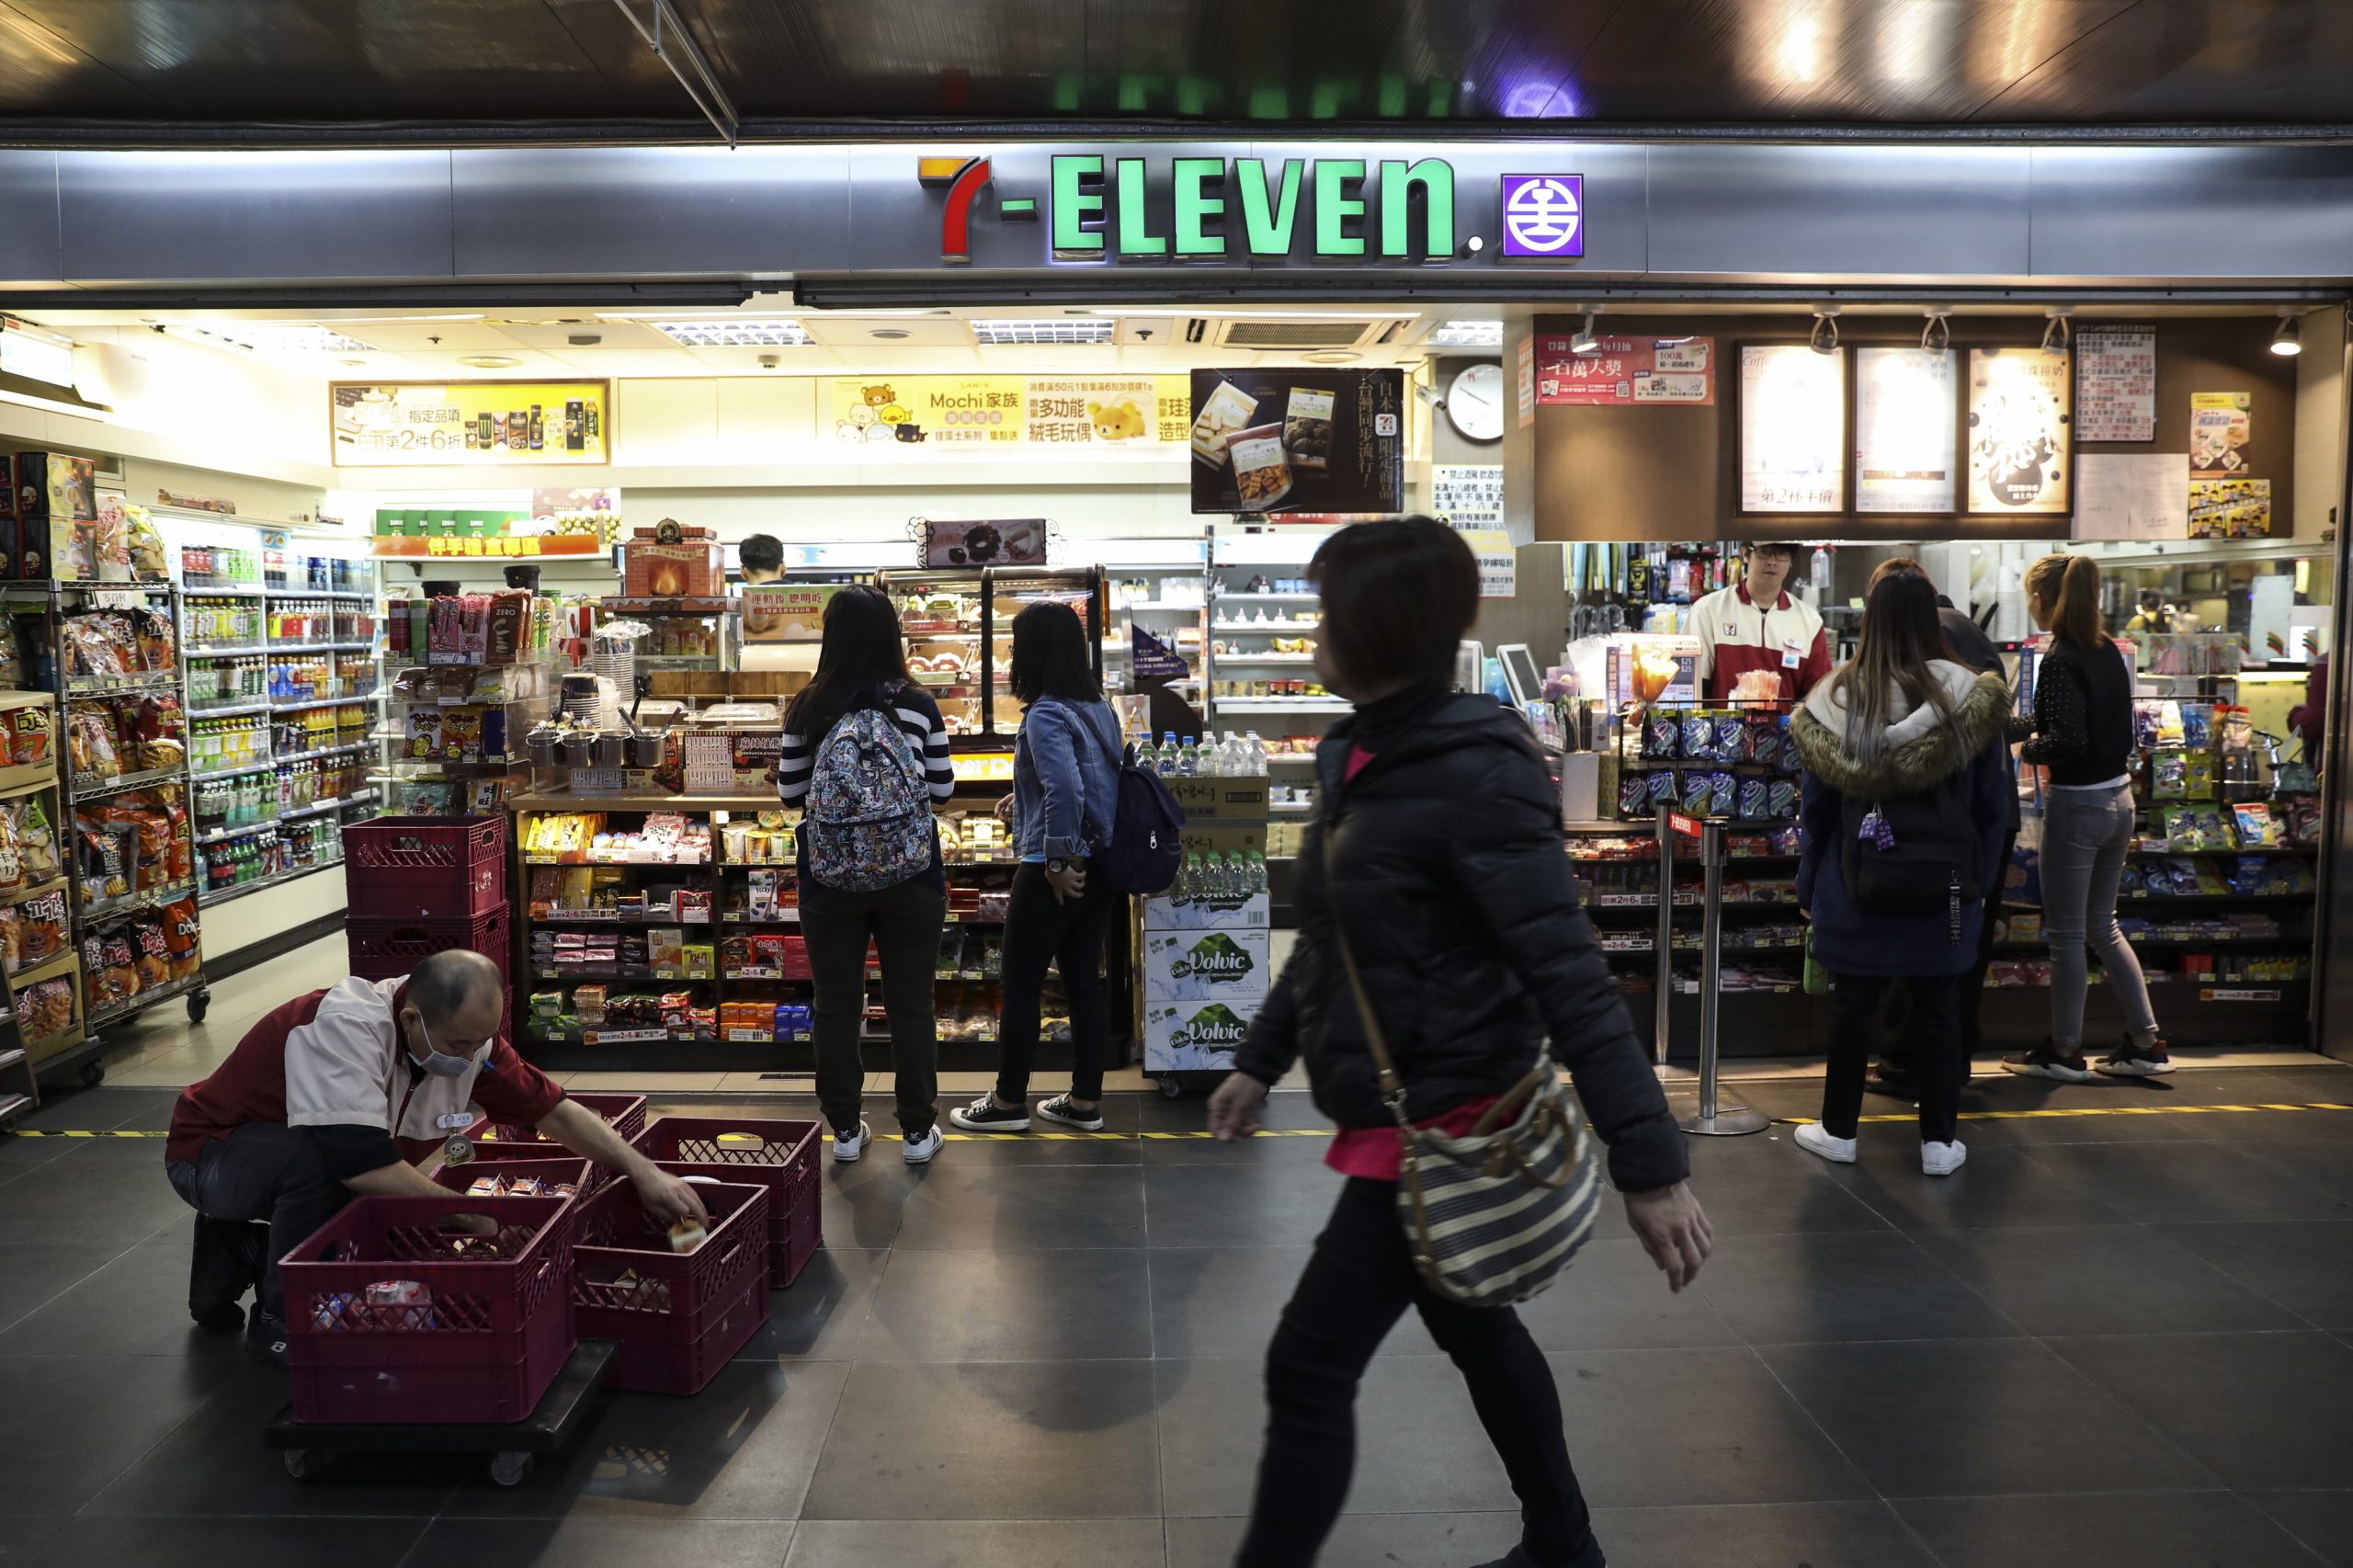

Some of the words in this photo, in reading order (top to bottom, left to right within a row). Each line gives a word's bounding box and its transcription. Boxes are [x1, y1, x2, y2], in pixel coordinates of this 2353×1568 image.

[929, 392, 983, 409] Mochi
[986, 392, 1018, 409] 家族
[1379, 381, 1393, 412] 日本
[409, 409, 460, 424] 指定品項
[1040, 398, 1085, 419] 多功能
[385, 429, 460, 450] 第2件6折
[1029, 422, 1092, 443] 絨毛玩偶
[1379, 438, 1393, 499] 限定商品
[752, 594, 784, 605] 運動後
[1189, 950, 1245, 970] Volvic
[1188, 1021, 1245, 1040] Volvic
